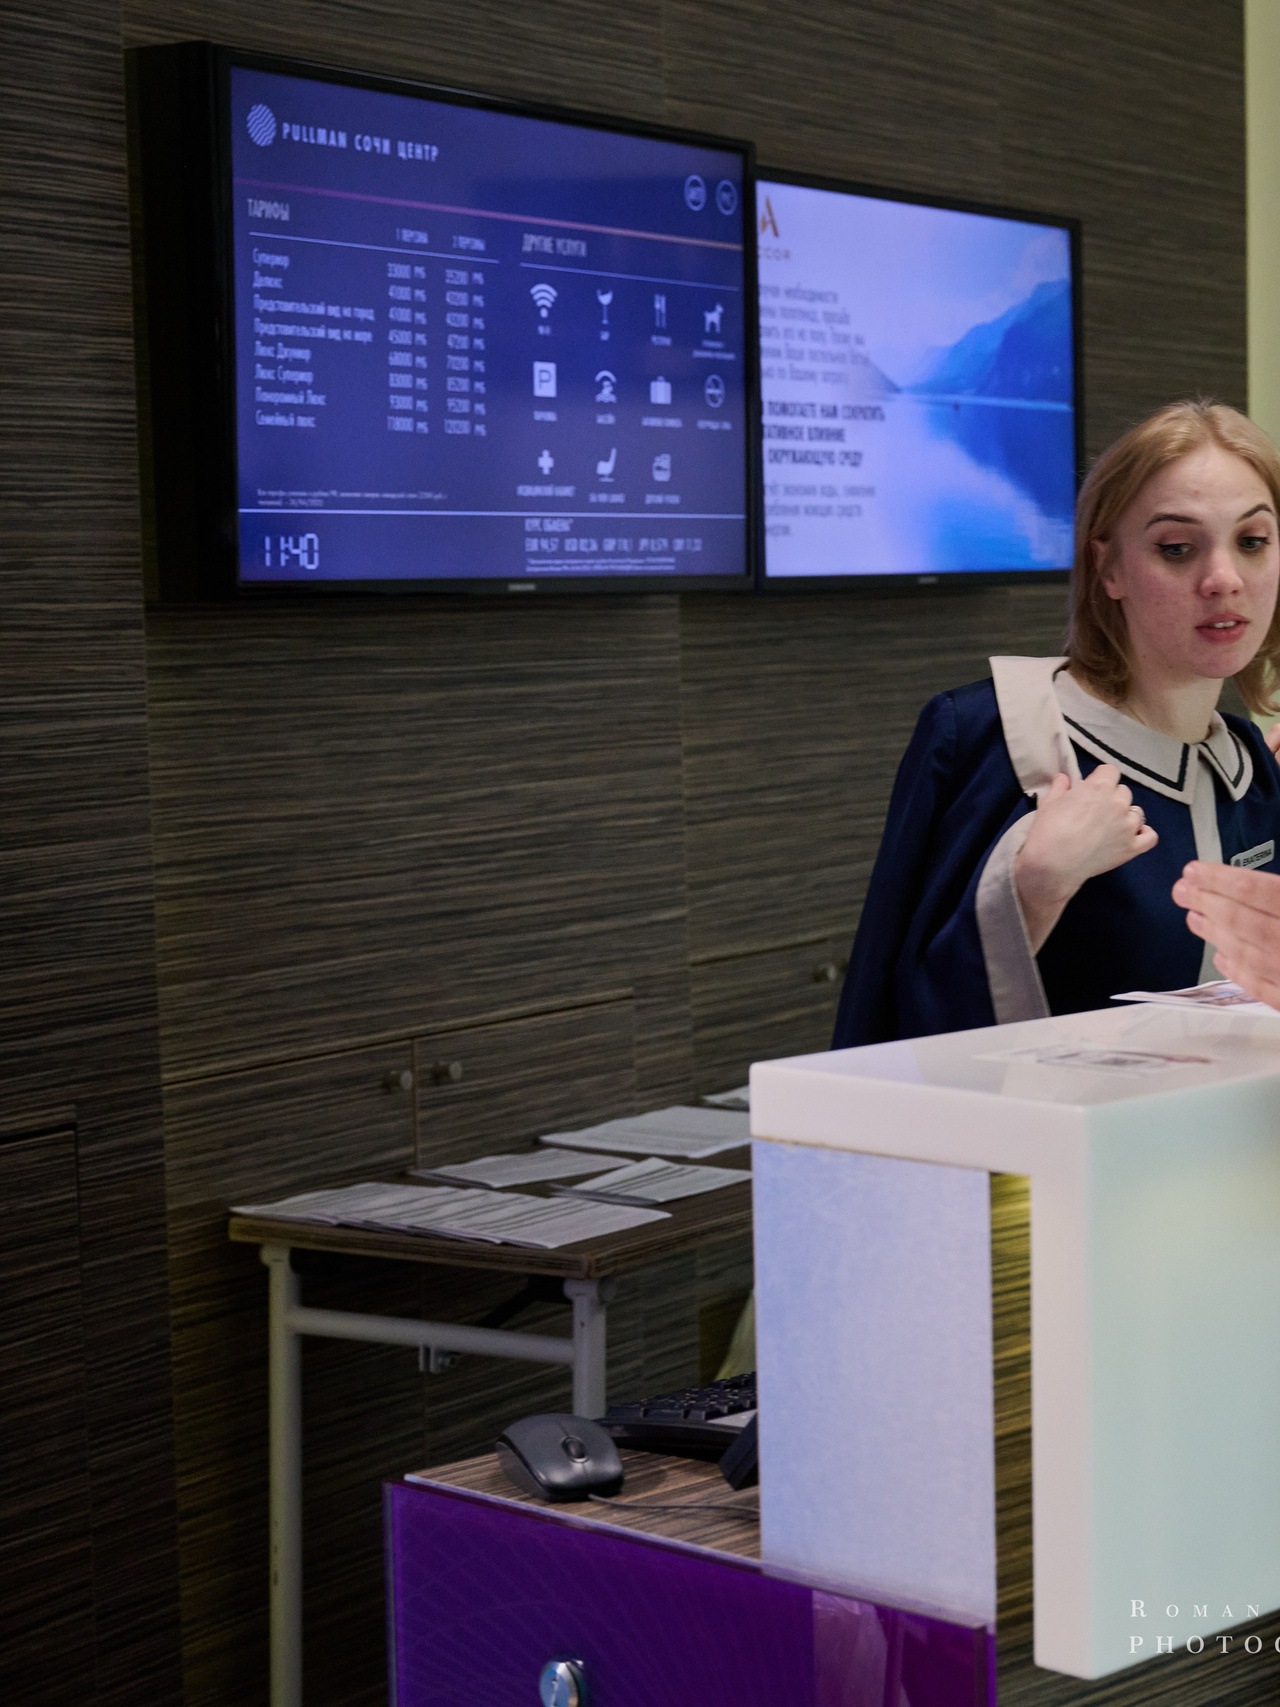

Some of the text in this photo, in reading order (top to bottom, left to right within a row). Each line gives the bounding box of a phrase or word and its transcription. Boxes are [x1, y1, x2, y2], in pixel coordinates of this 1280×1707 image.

[282, 122, 439, 162] PULLMAN СОЧИ ЦЕНТР
[264, 533, 319, 570] 11:40
